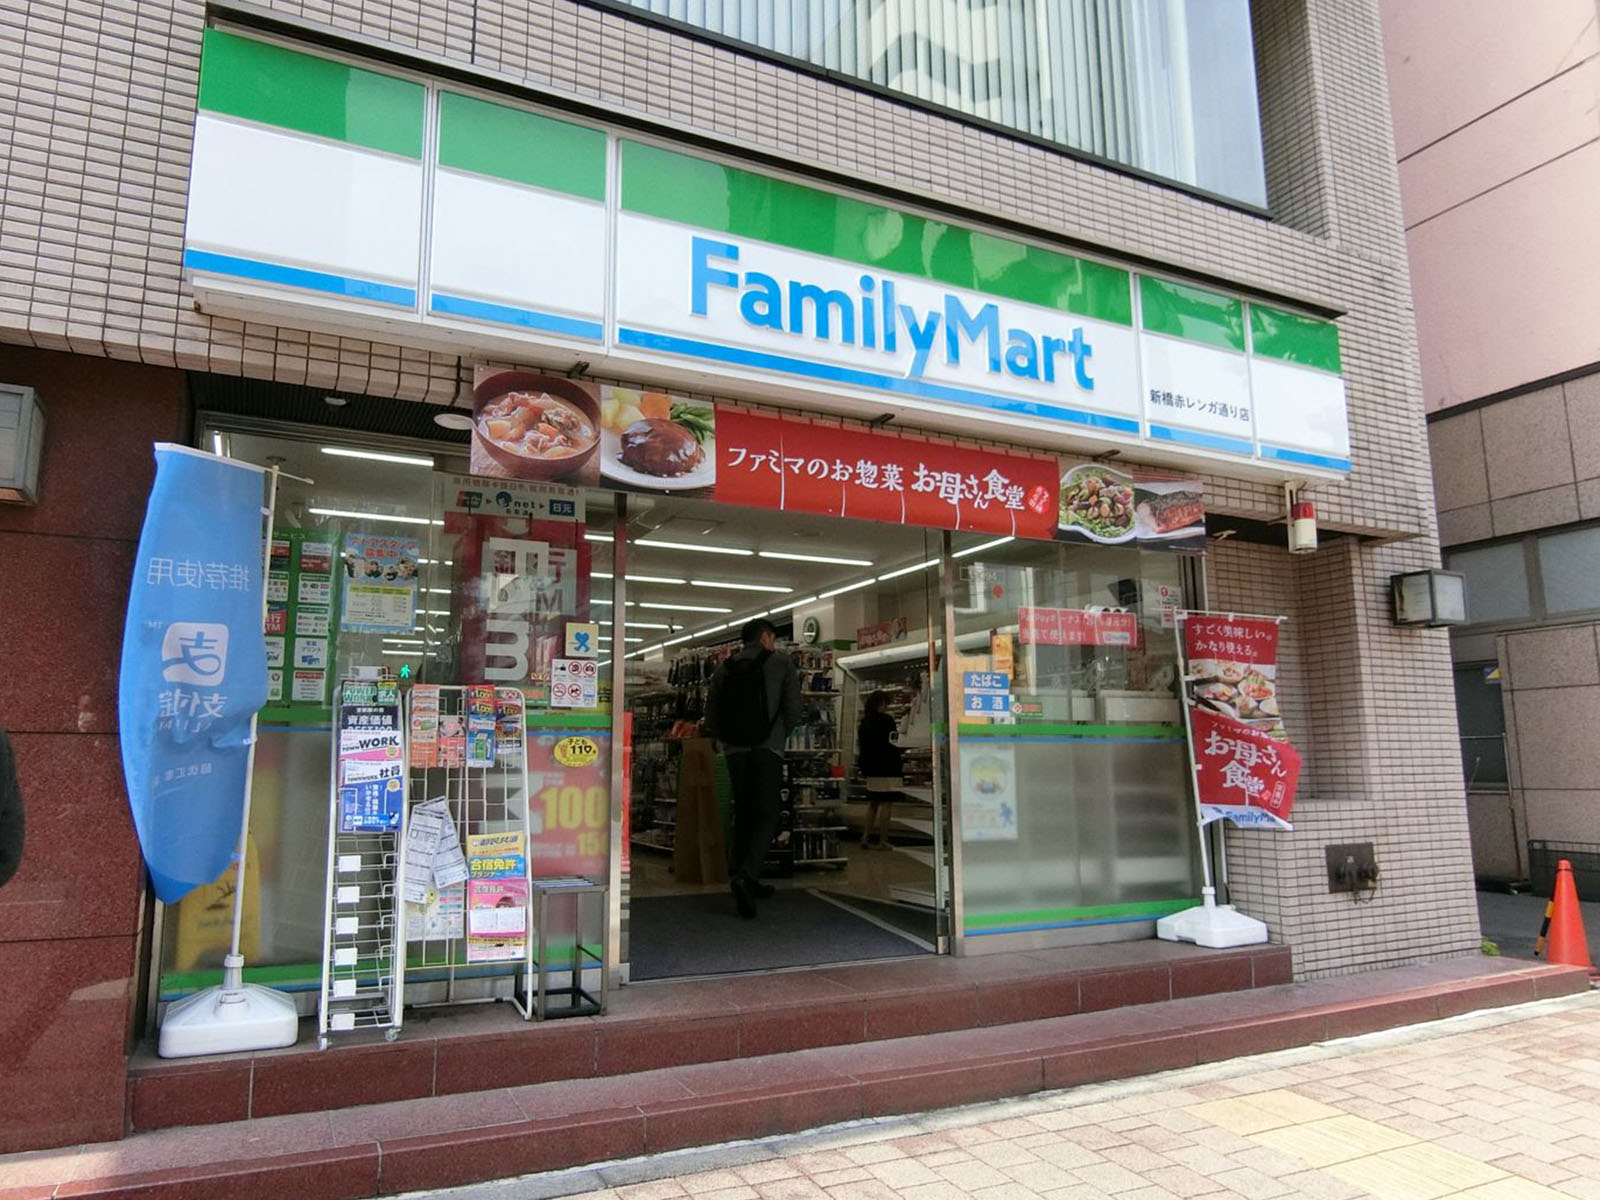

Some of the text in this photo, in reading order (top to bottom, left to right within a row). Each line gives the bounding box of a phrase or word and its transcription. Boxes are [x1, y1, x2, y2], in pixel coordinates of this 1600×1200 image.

[690, 235, 1095, 391] FamilyMart
[1149, 389, 1250, 422] 新橋赤レンガ通り店
[728, 447, 904, 491] ファミマのお惣菜
[911, 463, 1025, 510] お母さん食堂
[1192, 623, 1273, 640] すごく美味しい。
[1195, 640, 1258, 657] かなり使える。
[971, 674, 1003, 688] たばこ
[971, 695, 1003, 710] お酒
[347, 714, 393, 725] 資産価値
[359, 736, 400, 749] WORK
[1203, 729, 1287, 778] お母さん
[379, 765, 400, 779] 社員
[471, 858, 516, 871] 合宿免許
